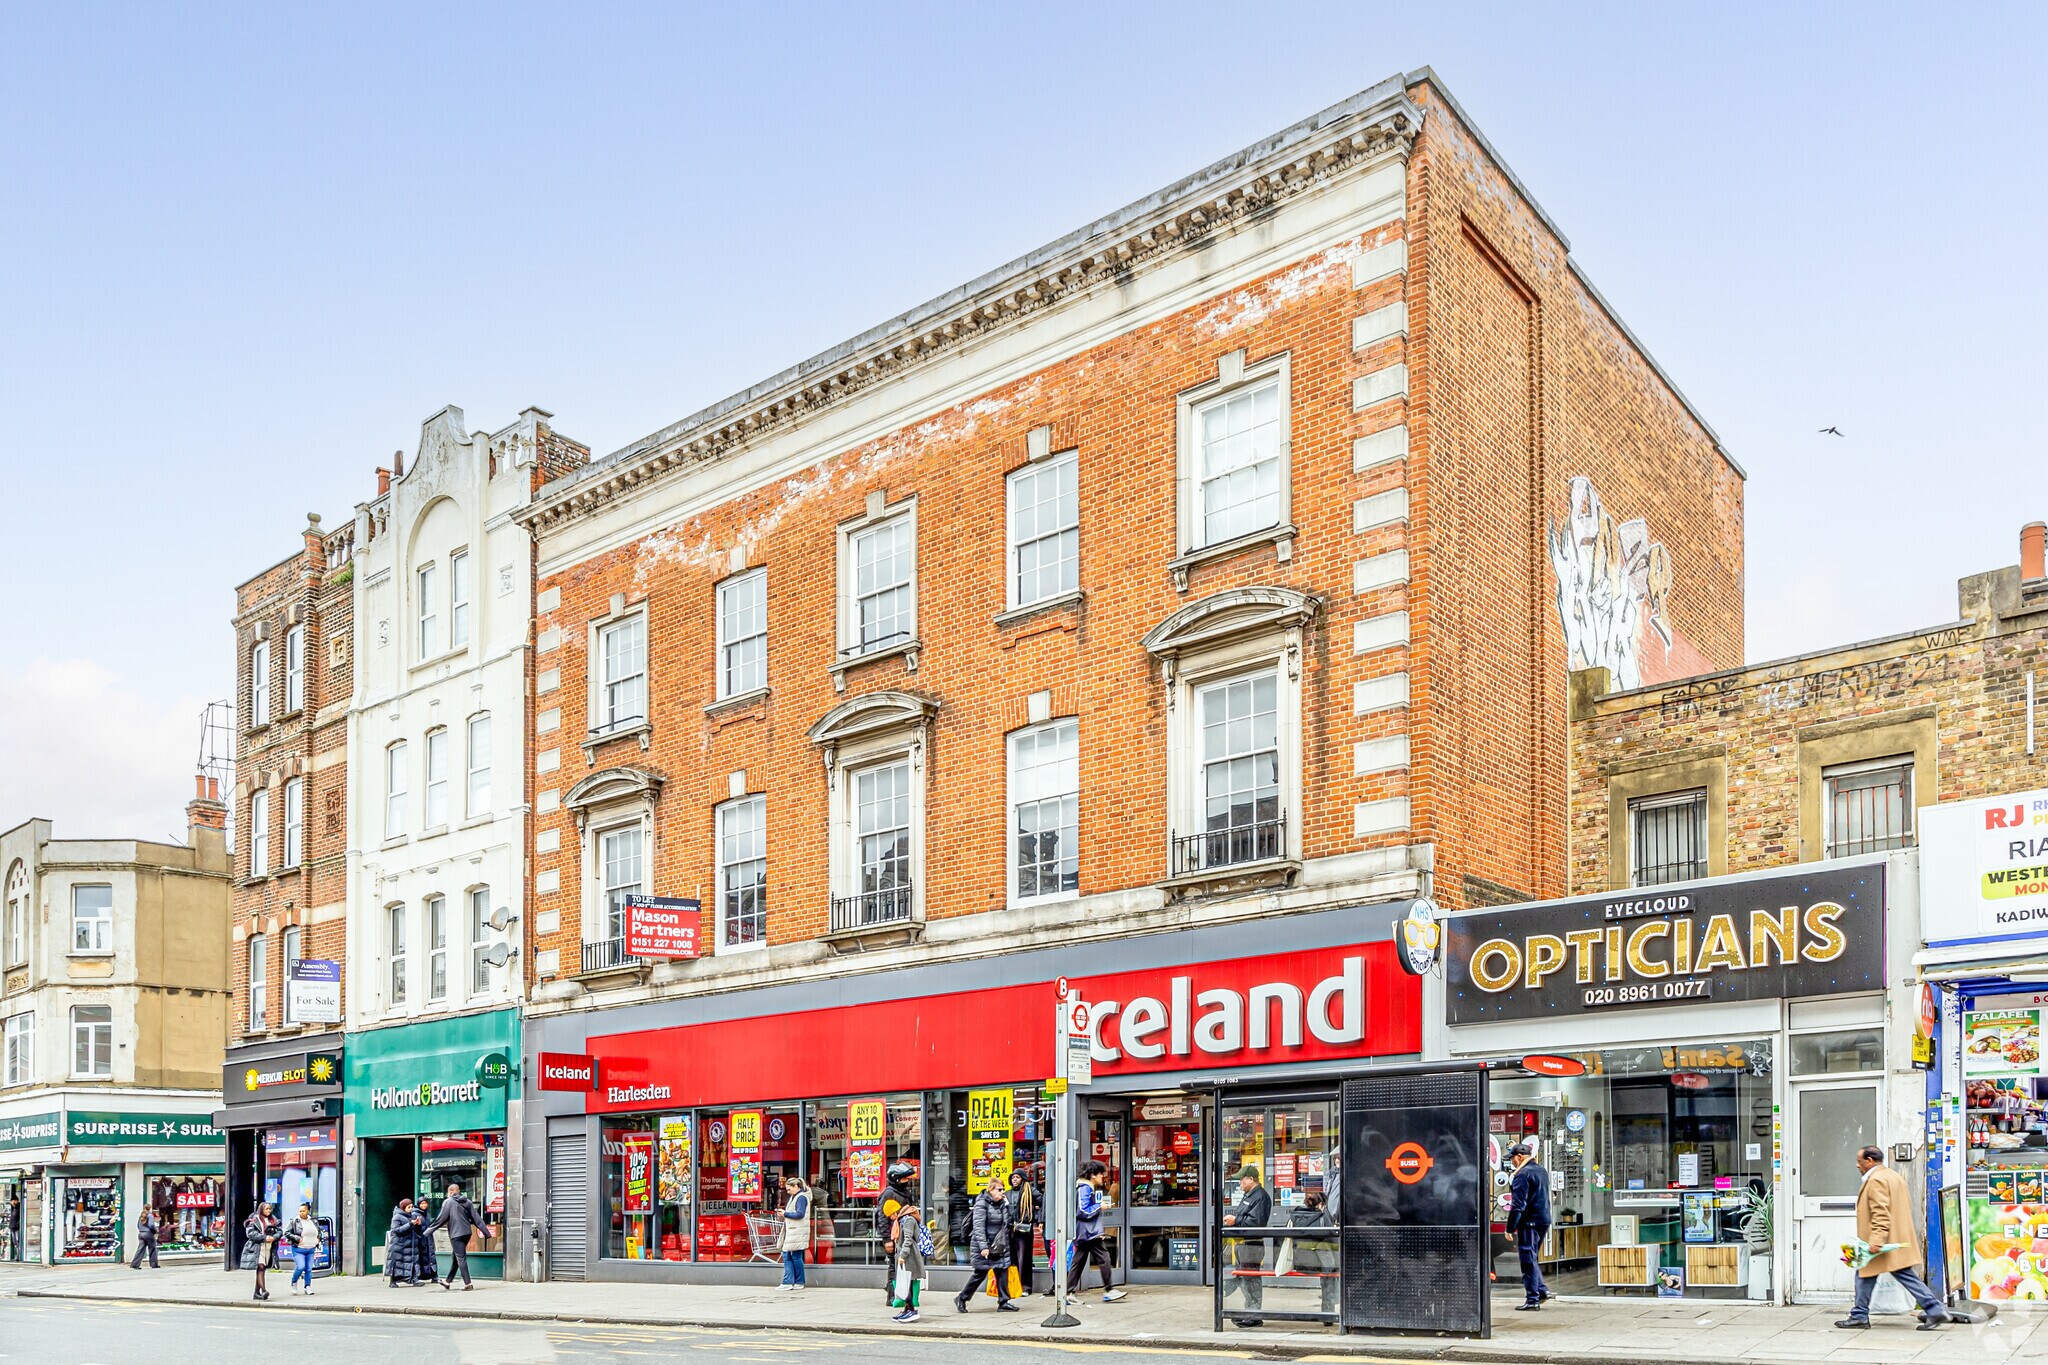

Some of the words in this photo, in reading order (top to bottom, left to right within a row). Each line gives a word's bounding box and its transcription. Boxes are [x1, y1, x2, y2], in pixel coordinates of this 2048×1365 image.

[1985, 804, 2024, 830] RJ
[632, 895, 641, 903] TO
[1415, 906, 1429, 920] NHS
[1605, 896, 1689, 918] EYECLOUD
[632, 909, 678, 924] Mason
[632, 922, 694, 938] Partners
[632, 938, 651, 947] 0151
[654, 939, 669, 948] 227
[672, 939, 692, 948] 1008
[1469, 901, 1847, 993] OPTICIANS
[1060, 978, 1067, 996] B
[1585, 988, 1614, 1005] 020
[1619, 986, 1658, 1002] 8961
[1664, 981, 1705, 997] 0077
[316, 997, 335, 1005] Sale
[1067, 956, 1366, 1062] celand
[1973, 1011, 2031, 1022] FALAFEL
[257, 1072, 282, 1084] MERKUR
[283, 1069, 305, 1081] SLOT
[546, 1065, 590, 1080] Iceland
[608, 1084, 671, 1103] Harlesden
[857, 1106, 869, 1115] ANY
[870, 1105, 877, 1115] 10
[972, 1096, 1009, 1119] DEAL
[74, 1123, 157, 1135] SURPRISE
[738, 1118, 754, 1129] HALF
[855, 1116, 878, 1136] £10
[972, 1121, 979, 1129] OF
[992, 1120, 1009, 1128] WEEK
[0, 1127, 12, 1141] ISE
[21, 1123, 57, 1139] SURPRISE
[736, 1131, 756, 1142] PRICE
[629, 1151, 648, 1168] 10%
[630, 1166, 645, 1180] OFF
[1133, 1163, 1165, 1171] Harlesden
[495, 1182, 504, 1190] Fre
[177, 1194, 214, 1205] SALE
[706, 1201, 737, 1209] ICELAND
